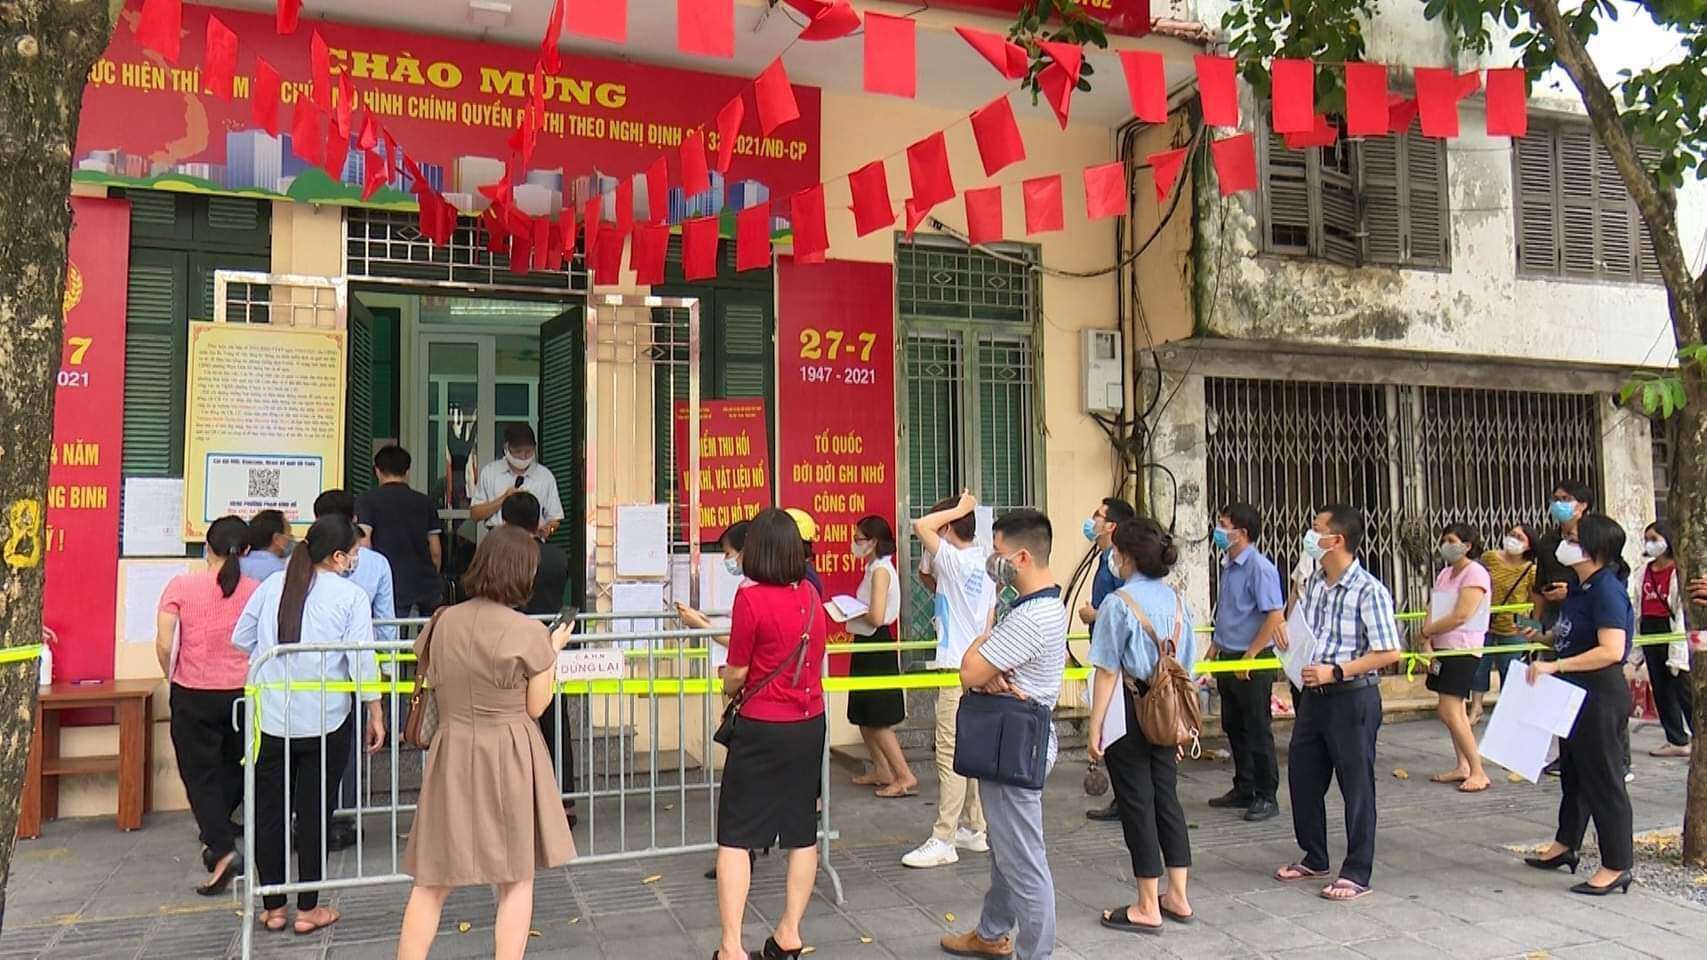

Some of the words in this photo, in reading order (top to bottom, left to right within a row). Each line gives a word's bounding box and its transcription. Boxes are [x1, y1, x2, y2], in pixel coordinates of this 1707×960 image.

[87, 58, 116, 89] ỰC
[122, 61, 165, 93] HIỆN
[329, 48, 462, 89] CHÀO
[408, 94, 457, 122] CHÍNH
[569, 114, 605, 139] THEO
[609, 120, 644, 148] NGHỊ
[648, 123, 682, 147] ĐỊNH
[799, 328, 877, 362] 27-7
[56, 371, 89, 387] 021
[799, 366, 833, 383] 1947
[844, 368, 876, 384] 2021
[63, 438, 100, 466] NĂM
[700, 428, 716, 457] IỂM
[717, 437, 735, 457] THU
[832, 429, 863, 455] QUỐC
[714, 464, 731, 494] VẬT
[732, 463, 751, 493] LIỆU
[793, 459, 813, 483] ĐỜI
[815, 460, 836, 483] ĐỜI
[838, 463, 858, 483] GHI
[861, 461, 885, 484] NHỚ
[69, 486, 108, 509] BINH
[814, 490, 846, 513] CÔNG
[848, 493, 864, 513] ƠN
[699, 502, 717, 529] ÔNG
[823, 523, 848, 542] ANH
[815, 550, 839, 576] LIỆT
